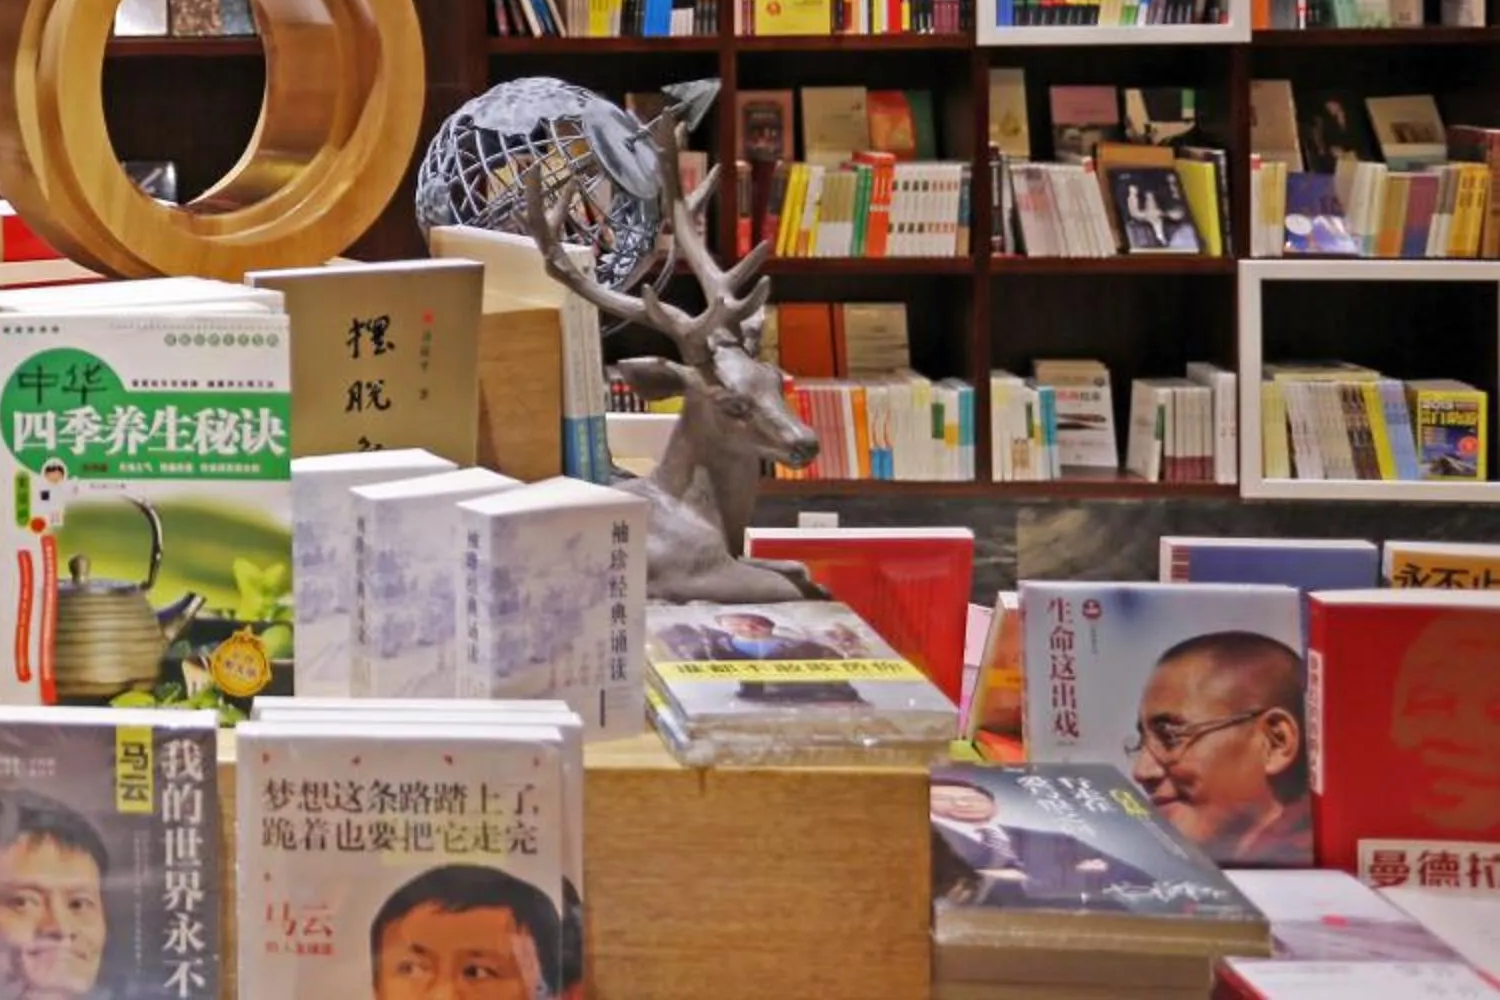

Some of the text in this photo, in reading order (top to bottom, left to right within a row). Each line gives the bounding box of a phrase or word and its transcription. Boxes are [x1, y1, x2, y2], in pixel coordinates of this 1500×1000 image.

[17, 362, 108, 406] 中华
[13, 404, 287, 456] 四季养生秘诀
[1047, 596, 1081, 739] 生命这出戏
[120, 741, 150, 803] 马云
[261, 816, 539, 856] 跪着也要把它走完
[264, 901, 335, 938] 马云
